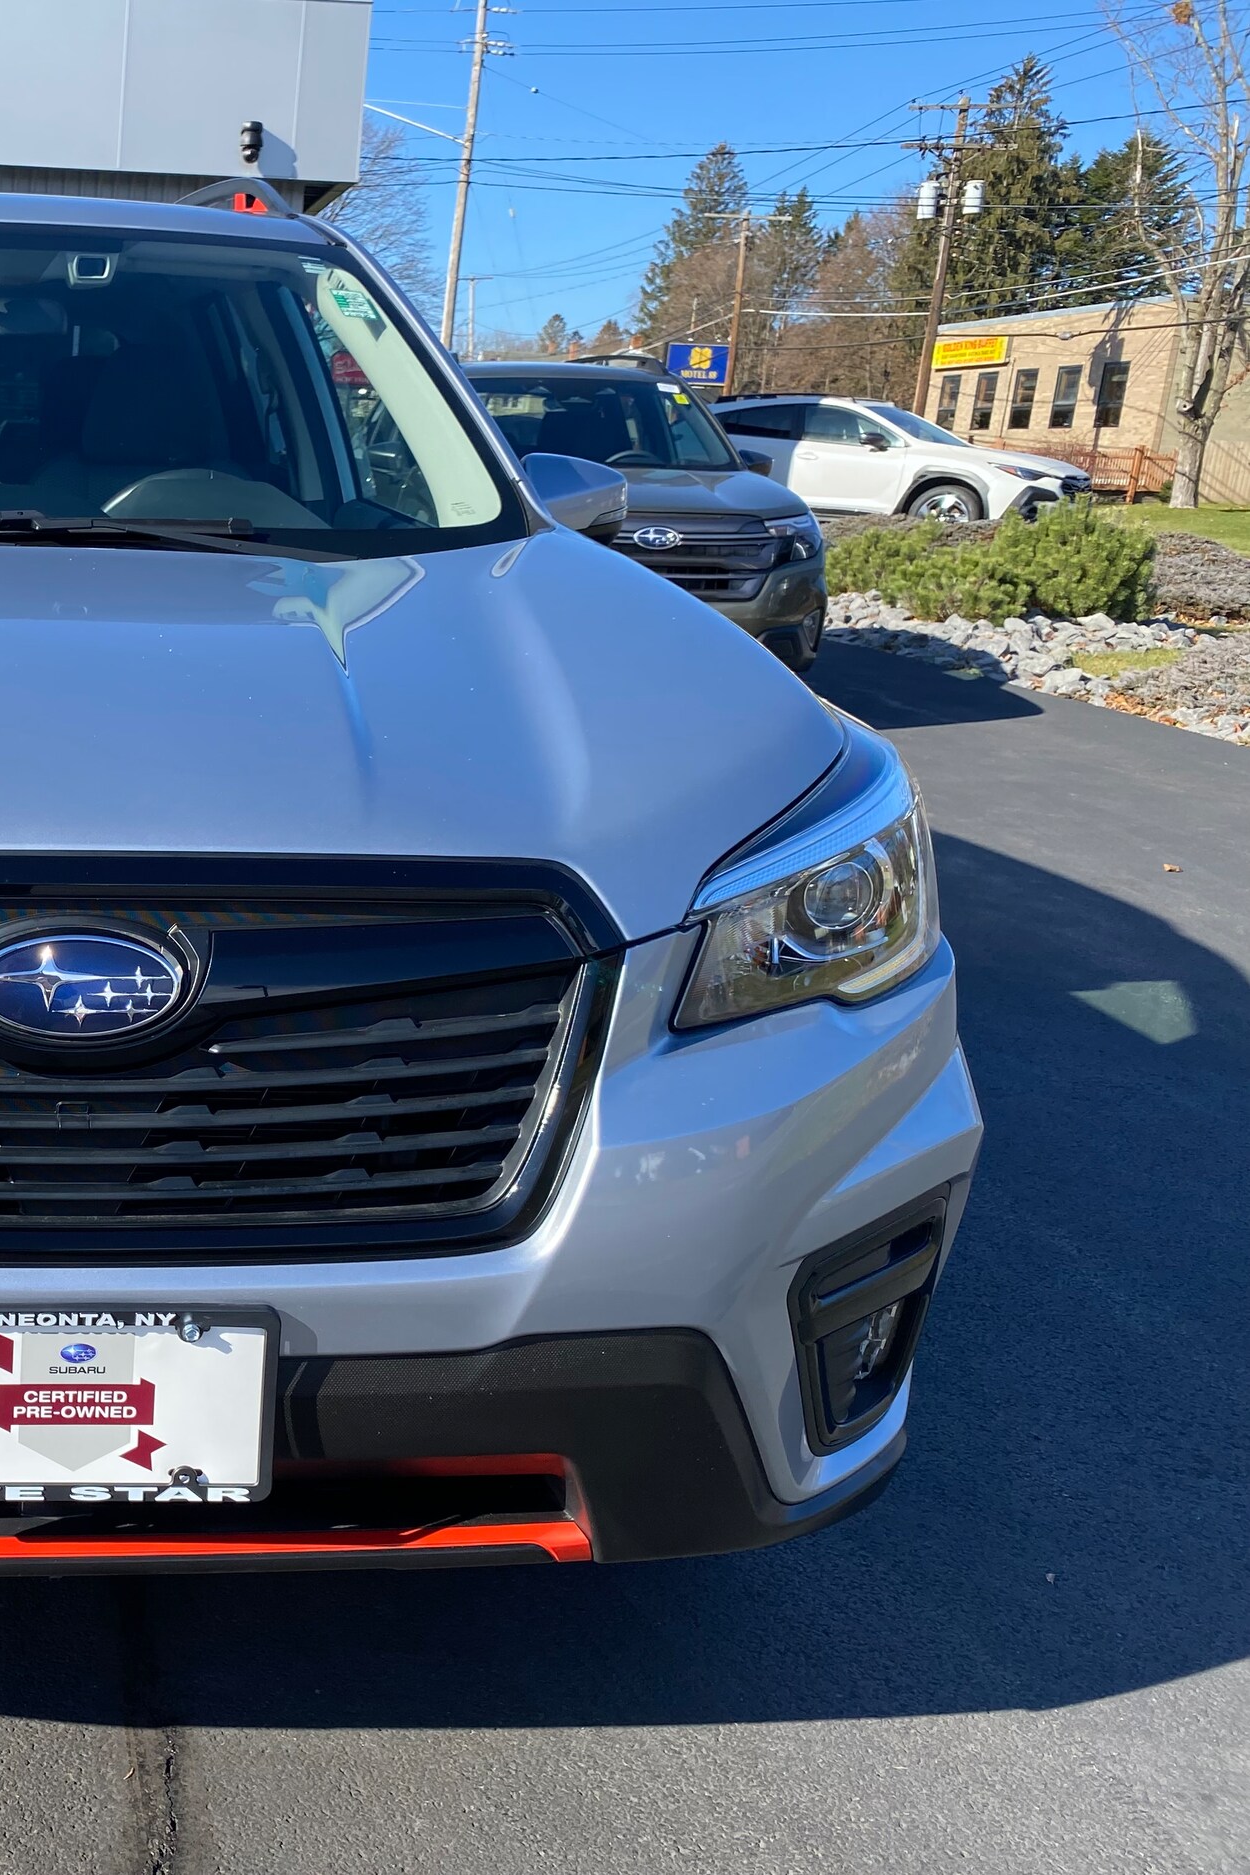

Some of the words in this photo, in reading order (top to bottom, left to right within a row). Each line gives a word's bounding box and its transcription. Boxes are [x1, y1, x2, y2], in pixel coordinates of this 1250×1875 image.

[681, 370, 707, 378] MOTEL
[135, 1313, 176, 1327] NY
[49, 1366, 106, 1374] SUBARU
[23, 1390, 128, 1404] CERTIFIED
[12, 1406, 137, 1419] PRE-OWNED
[69, 1486, 250, 1501] STAR
